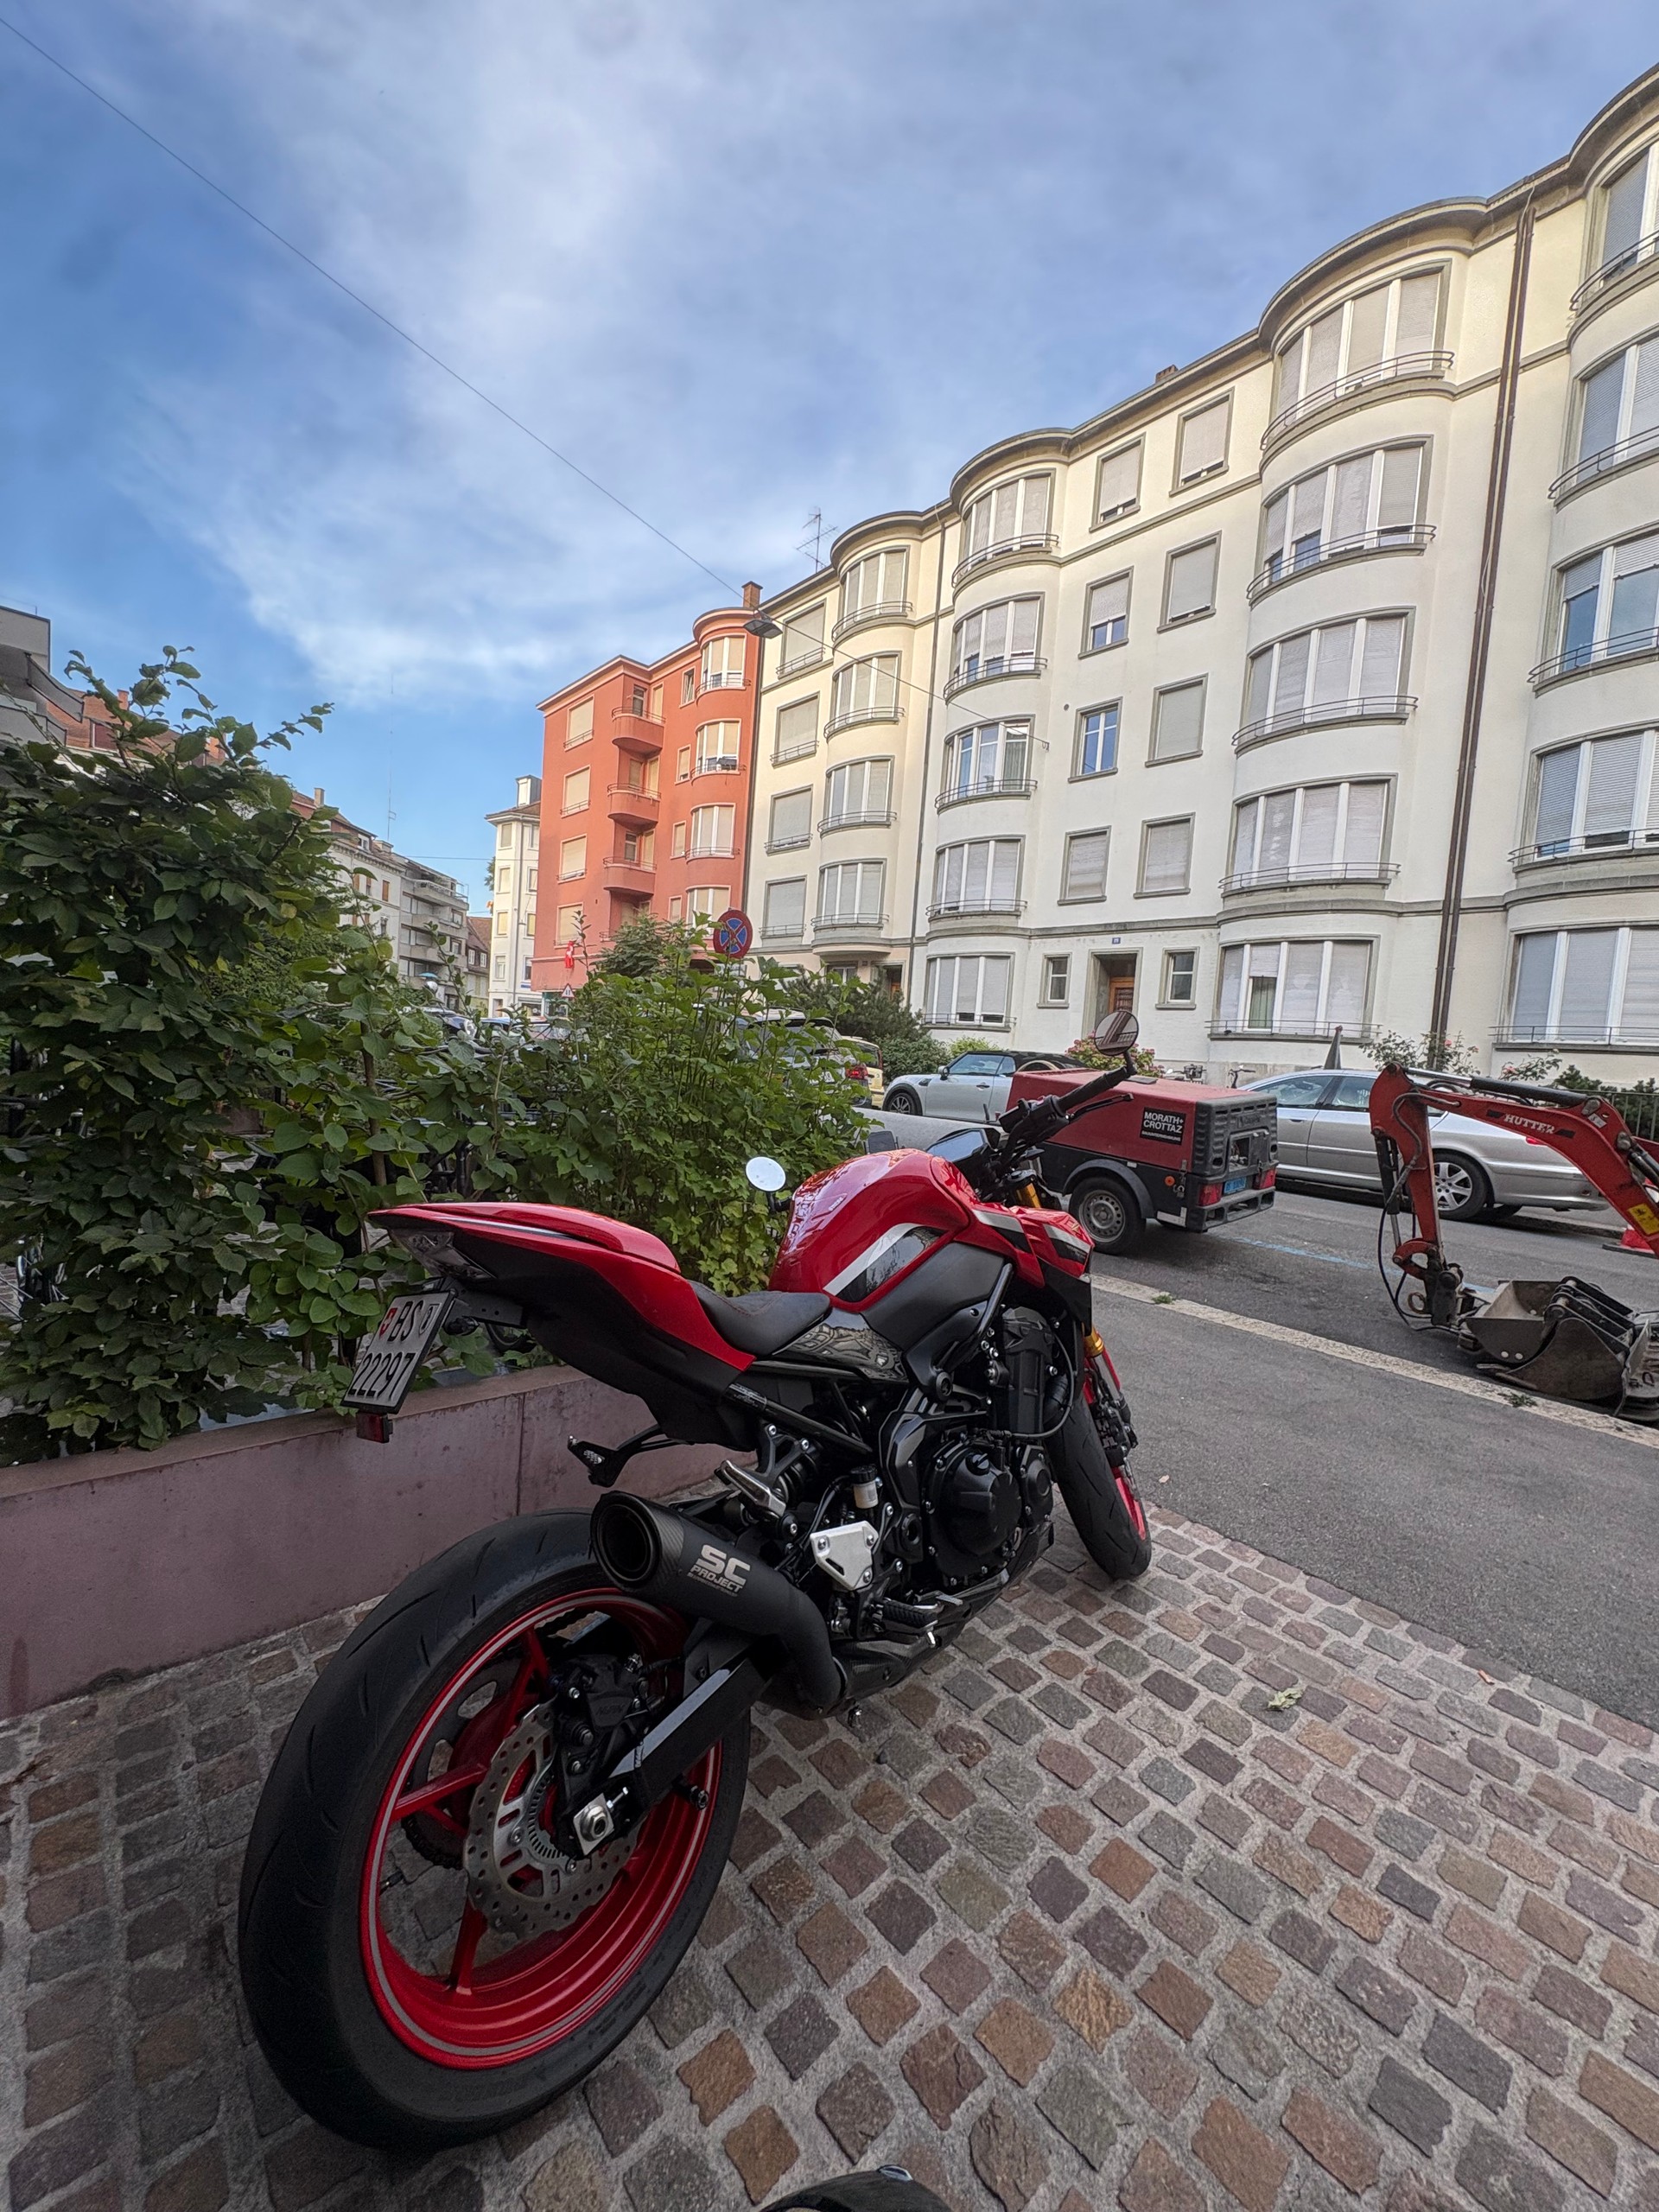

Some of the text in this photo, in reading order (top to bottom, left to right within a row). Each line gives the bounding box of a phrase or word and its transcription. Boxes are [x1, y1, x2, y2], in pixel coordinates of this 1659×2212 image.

[1143, 1120, 1183, 1133] CROTTAZ
[1144, 1111, 1184, 1124] MORATH+
[1503, 1114, 1554, 1134] HUTTER
[388, 1300, 423, 1341] BS
[348, 1352, 416, 1400] 22297
[690, 1565, 743, 1592] PROJECT
[696, 1545, 750, 1586] SC
